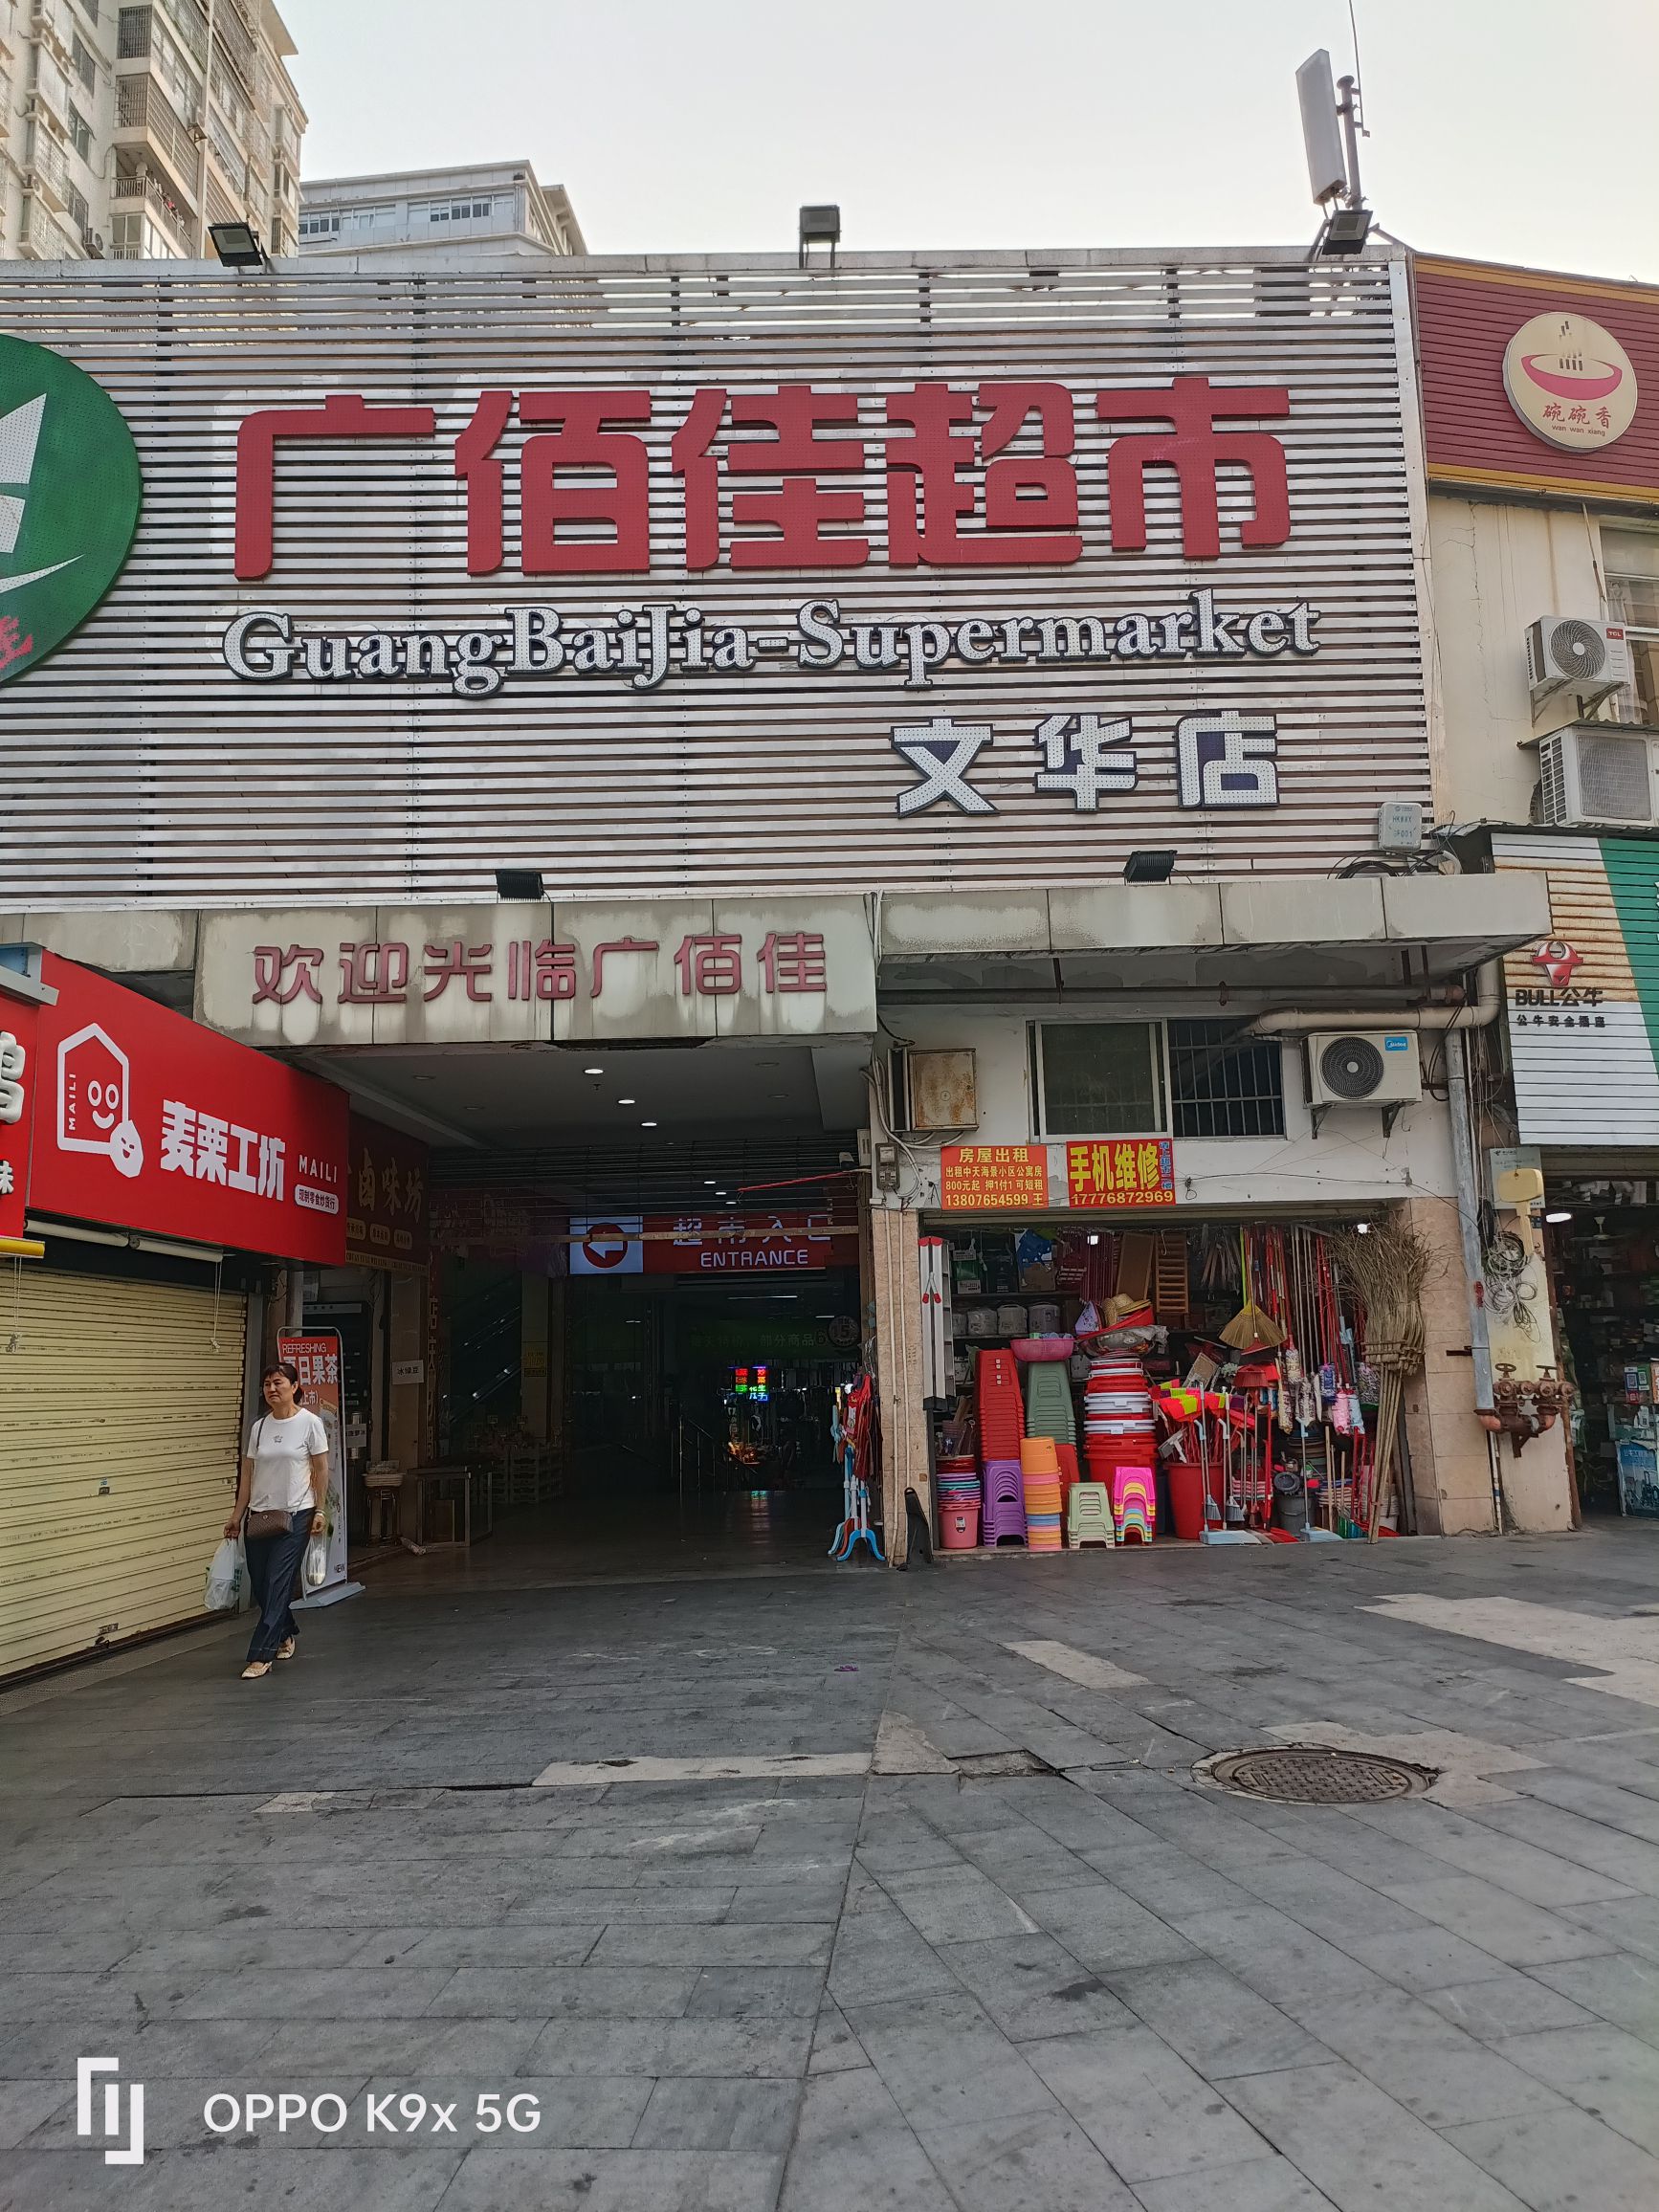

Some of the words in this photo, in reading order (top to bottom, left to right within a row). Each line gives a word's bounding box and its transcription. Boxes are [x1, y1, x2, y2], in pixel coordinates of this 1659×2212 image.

[1542, 402, 1612, 430] 碗碗香
[1551, 423, 1567, 433] wan
[1569, 426, 1584, 434] wan
[1587, 427, 1606, 437] xiang
[233, 377, 1291, 581] 广佰佳超市
[222, 587, 1321, 697] GuangBaiJia-Supermarket
[889, 709, 1280, 819] 文华店
[252, 932, 830, 1006] 欢迎光临广佰佳
[1516, 1013, 1606, 1029] 公牛安全插座
[1386, 1040, 1407, 1049] Midea
[67, 1073, 77, 1131] MAILI
[160, 1098, 286, 1202] 麦栗工坊
[959, 1147, 1029, 1163] 房屋出租
[299, 1154, 338, 1183] MAILI
[945, 1165, 1043, 1178] 出租中天海景小区公寓房
[1070, 1141, 1161, 1193] 手机维修
[348, 1147, 424, 1225] 卤味坊
[945, 1180, 981, 1191] 800元起
[984, 1179, 1013, 1191] 押1付1
[1016, 1179, 1044, 1191] 可短租
[299, 1188, 336, 1210] 现制零食炒货行
[945, 1193, 1029, 1206] 13807654599
[1031, 1192, 1045, 1206] 王
[1072, 1190, 1174, 1206] 17776872969
[700, 1249, 809, 1269] ENTRANCE
[282, 1342, 327, 1354] REFRESHING
